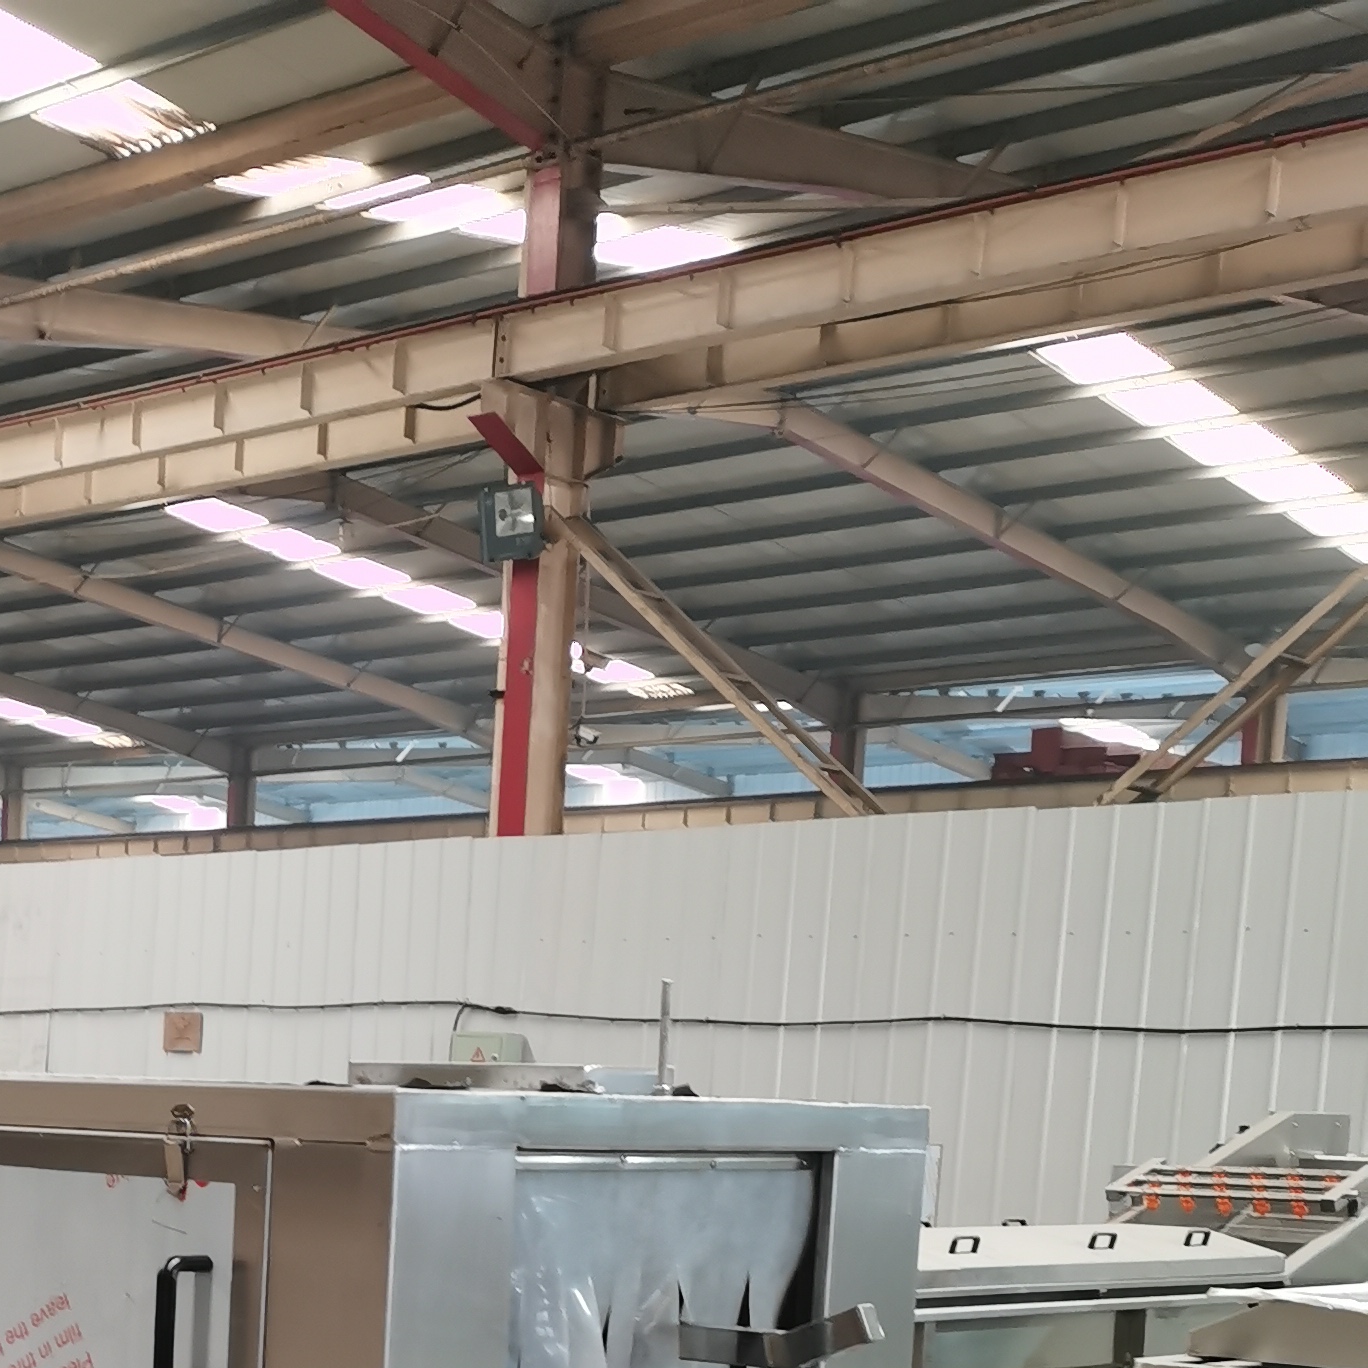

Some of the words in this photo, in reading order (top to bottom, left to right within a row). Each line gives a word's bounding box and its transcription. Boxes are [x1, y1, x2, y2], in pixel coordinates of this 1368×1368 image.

[30, 1293, 71, 1328] leave
[5, 1321, 29, 1345] the
[54, 1323, 82, 1348] film
[38, 1341, 52, 1360] in
